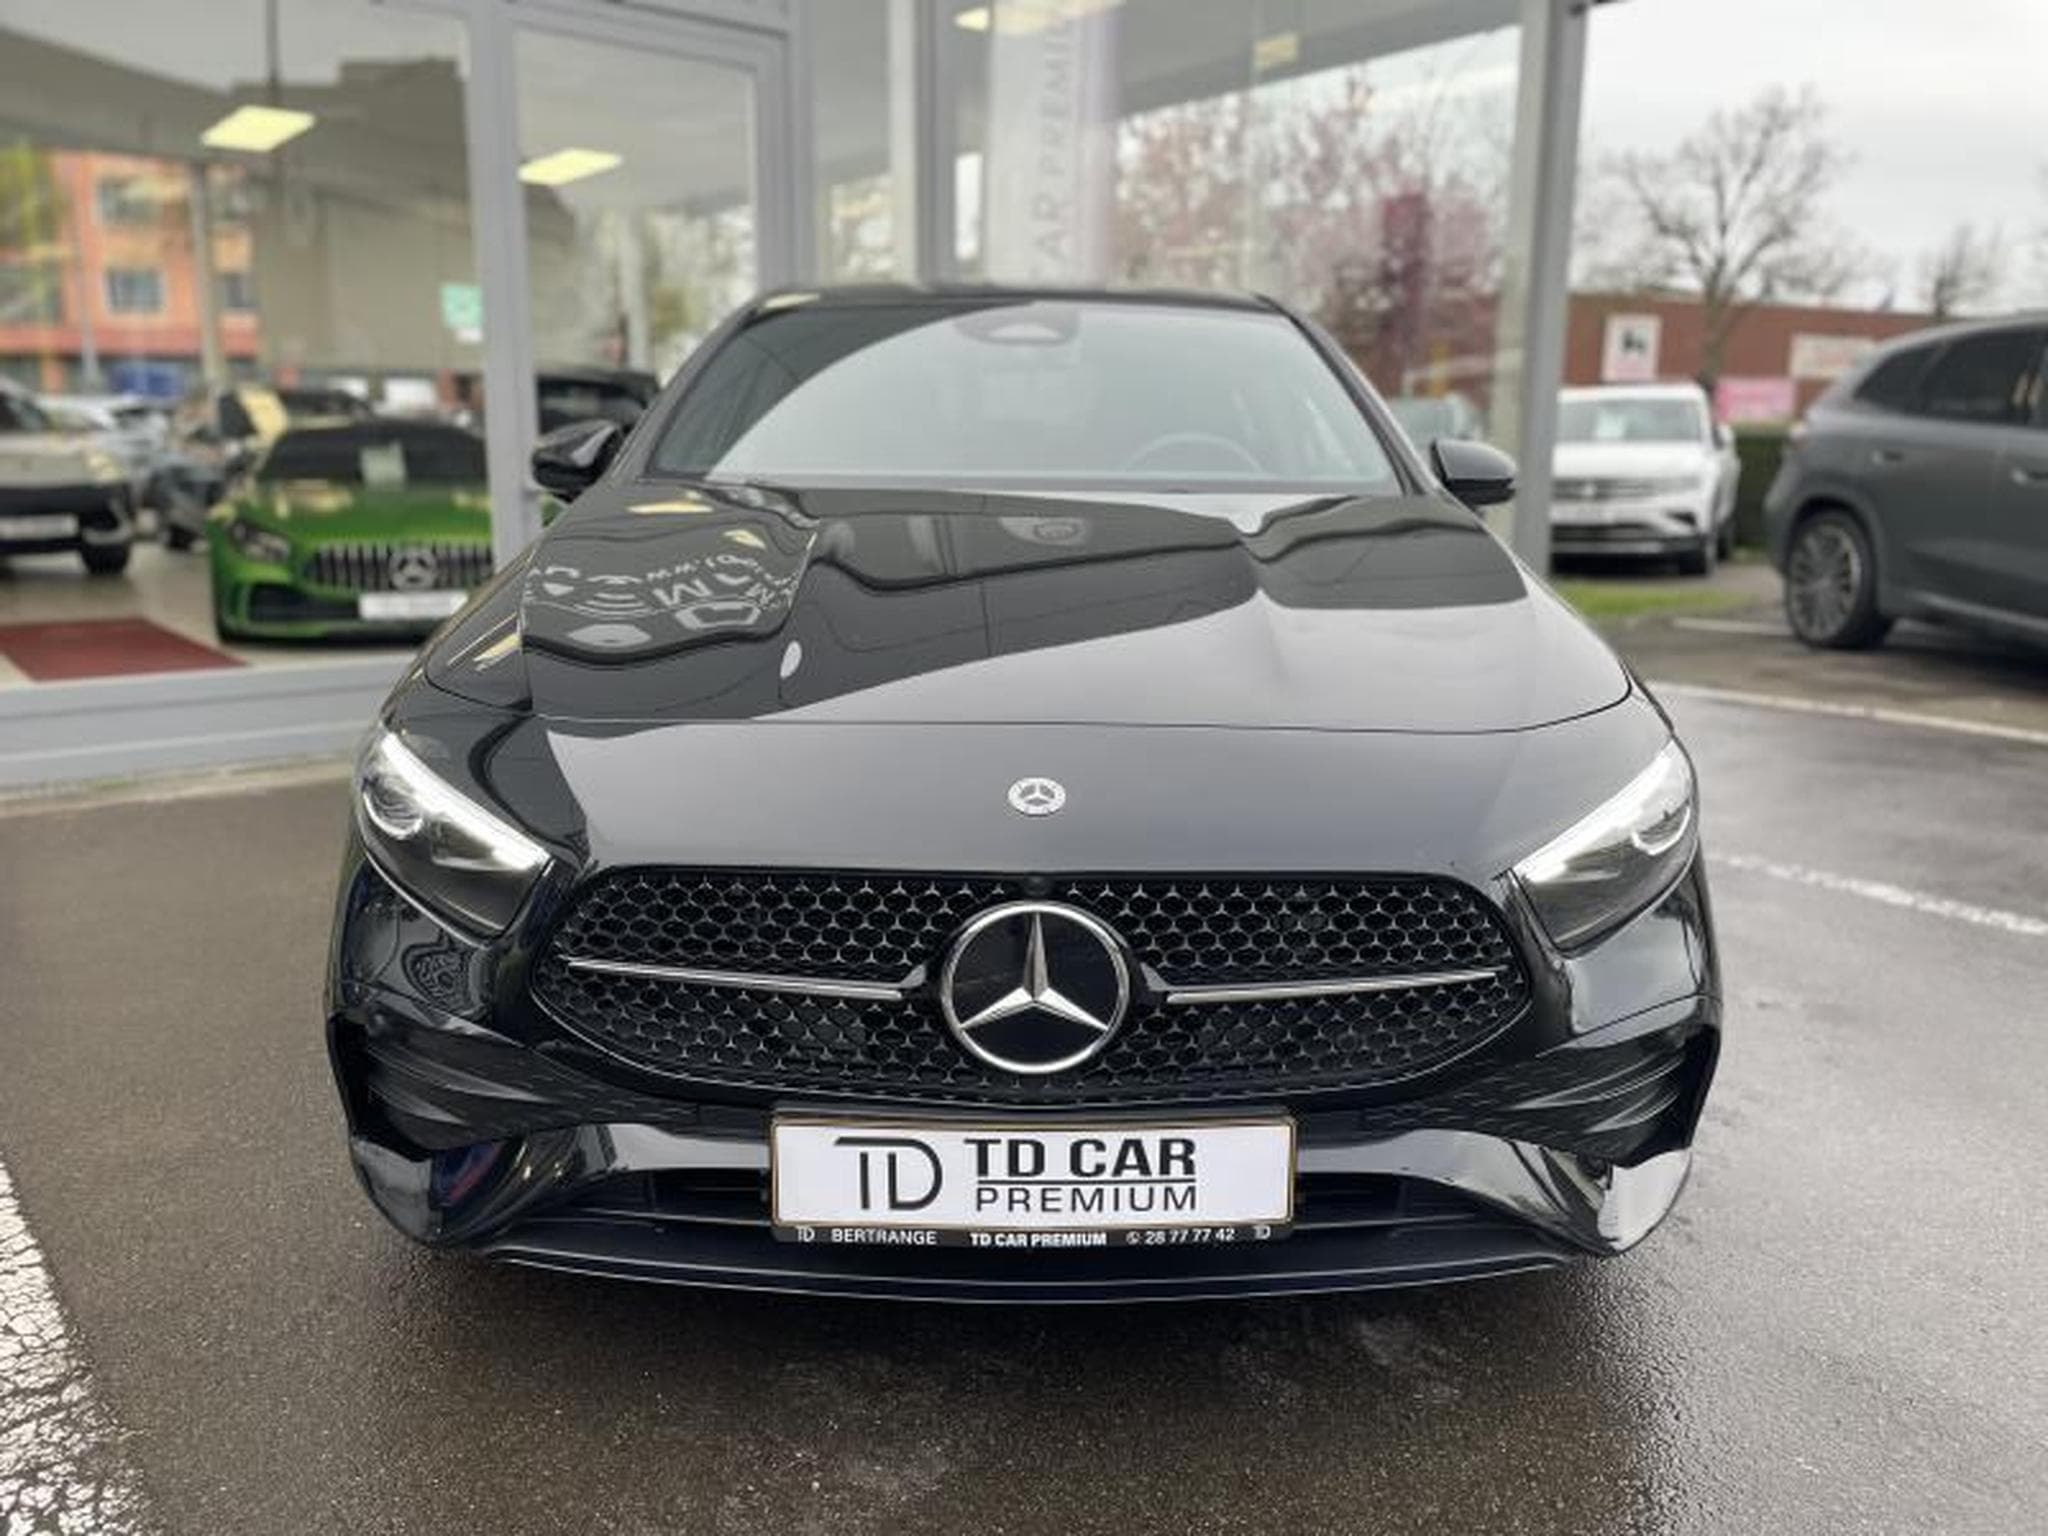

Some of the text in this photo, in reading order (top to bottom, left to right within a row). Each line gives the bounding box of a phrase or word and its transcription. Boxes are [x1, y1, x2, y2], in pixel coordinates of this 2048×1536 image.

[834, 1136, 943, 1211] TD
[963, 1138, 1197, 1178] TD CAR
[976, 1185, 1197, 1213] PREMIUM
[830, 1228, 938, 1246] BERTRANGE
[970, 1232, 991, 1247] TD
[995, 1233, 1029, 1248] CAR
[1030, 1231, 1108, 1248] PREMIUM
[1215, 1226, 1236, 1242] 42
